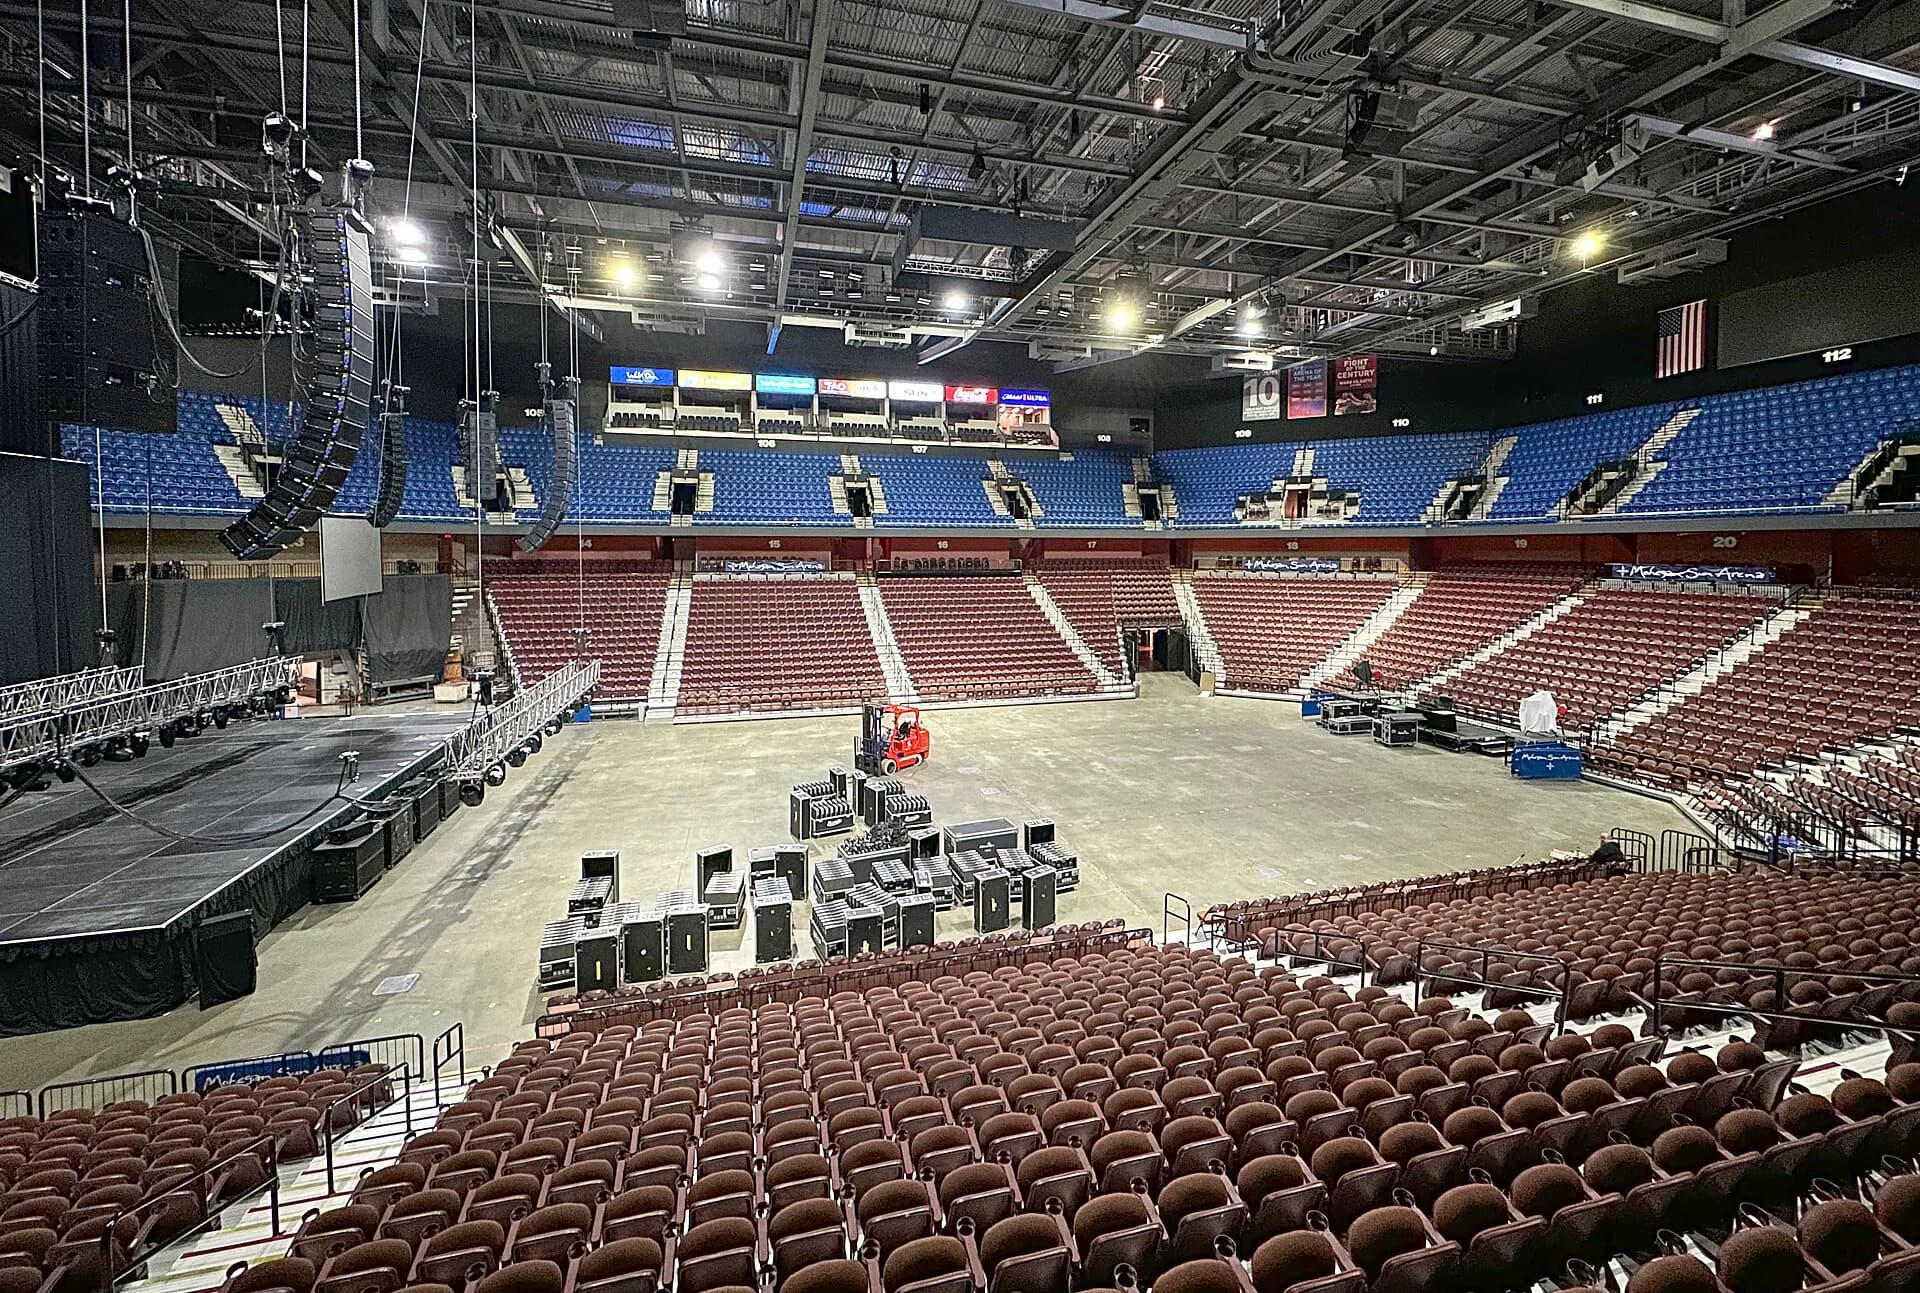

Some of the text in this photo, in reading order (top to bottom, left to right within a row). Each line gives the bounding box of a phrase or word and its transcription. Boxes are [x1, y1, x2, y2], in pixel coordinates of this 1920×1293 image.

[1822, 348, 1852, 362] 112
[1344, 359, 1368, 367] FIGHT
[1337, 369, 1375, 379] CENTURY
[1244, 377, 1280, 407] 10
[1027, 393, 1048, 402] ULTRA
[1586, 394, 1602, 404] 111
[524, 408, 546, 417] 105
[1392, 418, 1410, 427] 110
[912, 445, 928, 454] 107
[768, 540, 781, 548] 15
[937, 541, 949, 549] 16
[1087, 541, 1097, 549] 17
[1286, 542, 1299, 550] 18
[1514, 539, 1528, 548] 19
[1713, 536, 1737, 548] 20
[1683, 568, 1713, 579] Sun
[1714, 567, 1765, 580] Arena
